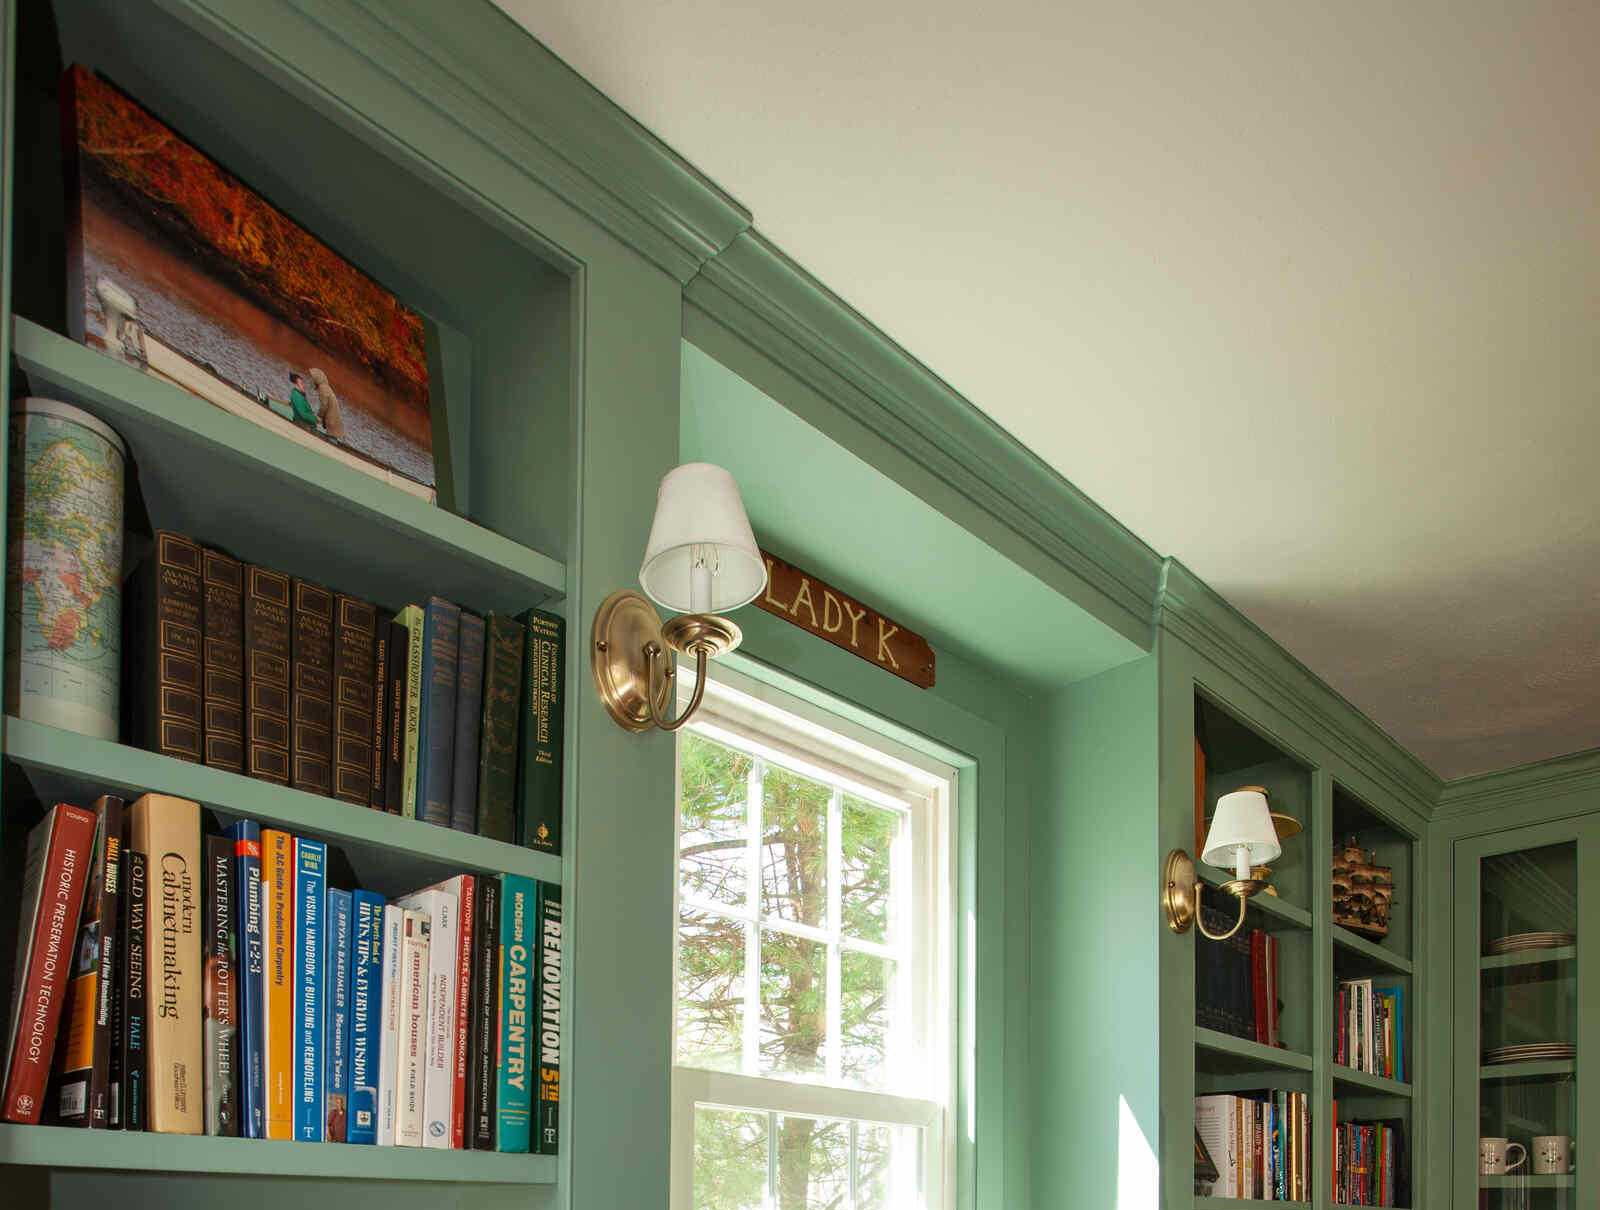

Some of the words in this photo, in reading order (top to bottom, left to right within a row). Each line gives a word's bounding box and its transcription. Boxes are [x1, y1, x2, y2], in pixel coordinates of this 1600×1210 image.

[765, 559, 866, 648] LADY
[878, 618, 899, 670] K
[410, 627, 421, 698] GRASSHOPPER
[540, 641, 551, 688] CLINICAL
[551, 643, 559, 692] FOUNDATIONS
[408, 705, 417, 734] BOOK
[539, 690, 551, 743] RESEARCH
[106, 836, 120, 861] SMALL
[276, 835, 284, 850] The
[276, 852, 284, 866] JLC
[56, 849, 77, 899] HISTORIC
[104, 862, 117, 894] HOUSES
[131, 865, 144, 898] OLD
[276, 867, 284, 890] Guide
[305, 880, 316, 894] The
[131, 902, 143, 934] WAY
[181, 875, 196, 934] modern
[216, 856, 229, 940] MASTERING
[246, 866, 262, 934] Plumbing
[276, 892, 284, 901] to
[305, 895, 316, 926] VISUAL
[373, 905, 382, 916] The
[513, 892, 524, 941] MODERN
[41, 903, 67, 981] PRESERVATION
[159, 852, 188, 1020] Cabinetmaking
[275, 902, 284, 945] Production
[337, 912, 346, 948] BRYAN
[102, 936, 113, 956] Editors
[217, 942, 229, 959] the
[250, 939, 262, 974] 1-2-3
[274, 947, 284, 986] Carpentry
[304, 928, 316, 975] HANDBOOK
[357, 940, 370, 966] TIPS
[372, 941, 380, 956] Book
[100, 964, 110, 979] Fine
[129, 944, 142, 999] SEEING
[217, 960, 231, 1025] POTTER'S
[304, 977, 316, 985] of
[336, 950, 345, 1007] BAEUMLER
[357, 966, 369, 977] &
[410, 951, 422, 1010] american
[541, 919, 560, 1065] RENOVATION
[97, 979, 109, 1026] Homebuilding
[304, 986, 316, 1028] BUILDING
[354, 978, 368, 1032] EVERYDAY
[437, 974, 448, 1032] INDEPENDENT
[460, 976, 468, 1018] CABINETS
[506, 944, 526, 1091] CARPENTRY
[26, 984, 52, 1064] TECHNOLOGY
[129, 1015, 142, 1049] HALE
[304, 1030, 314, 1045] and
[334, 1013, 344, 1056] Measure
[410, 1014, 421, 1057] houses
[218, 1028, 231, 1078] WHEEL
[334, 1058, 342, 1088] Twice
[353, 1037, 367, 1086] WISDOM
[436, 1034, 446, 1069] BUILDER
[458, 1028, 466, 1078] BOOKCASES
[303, 1046, 314, 1102] REMODELING
